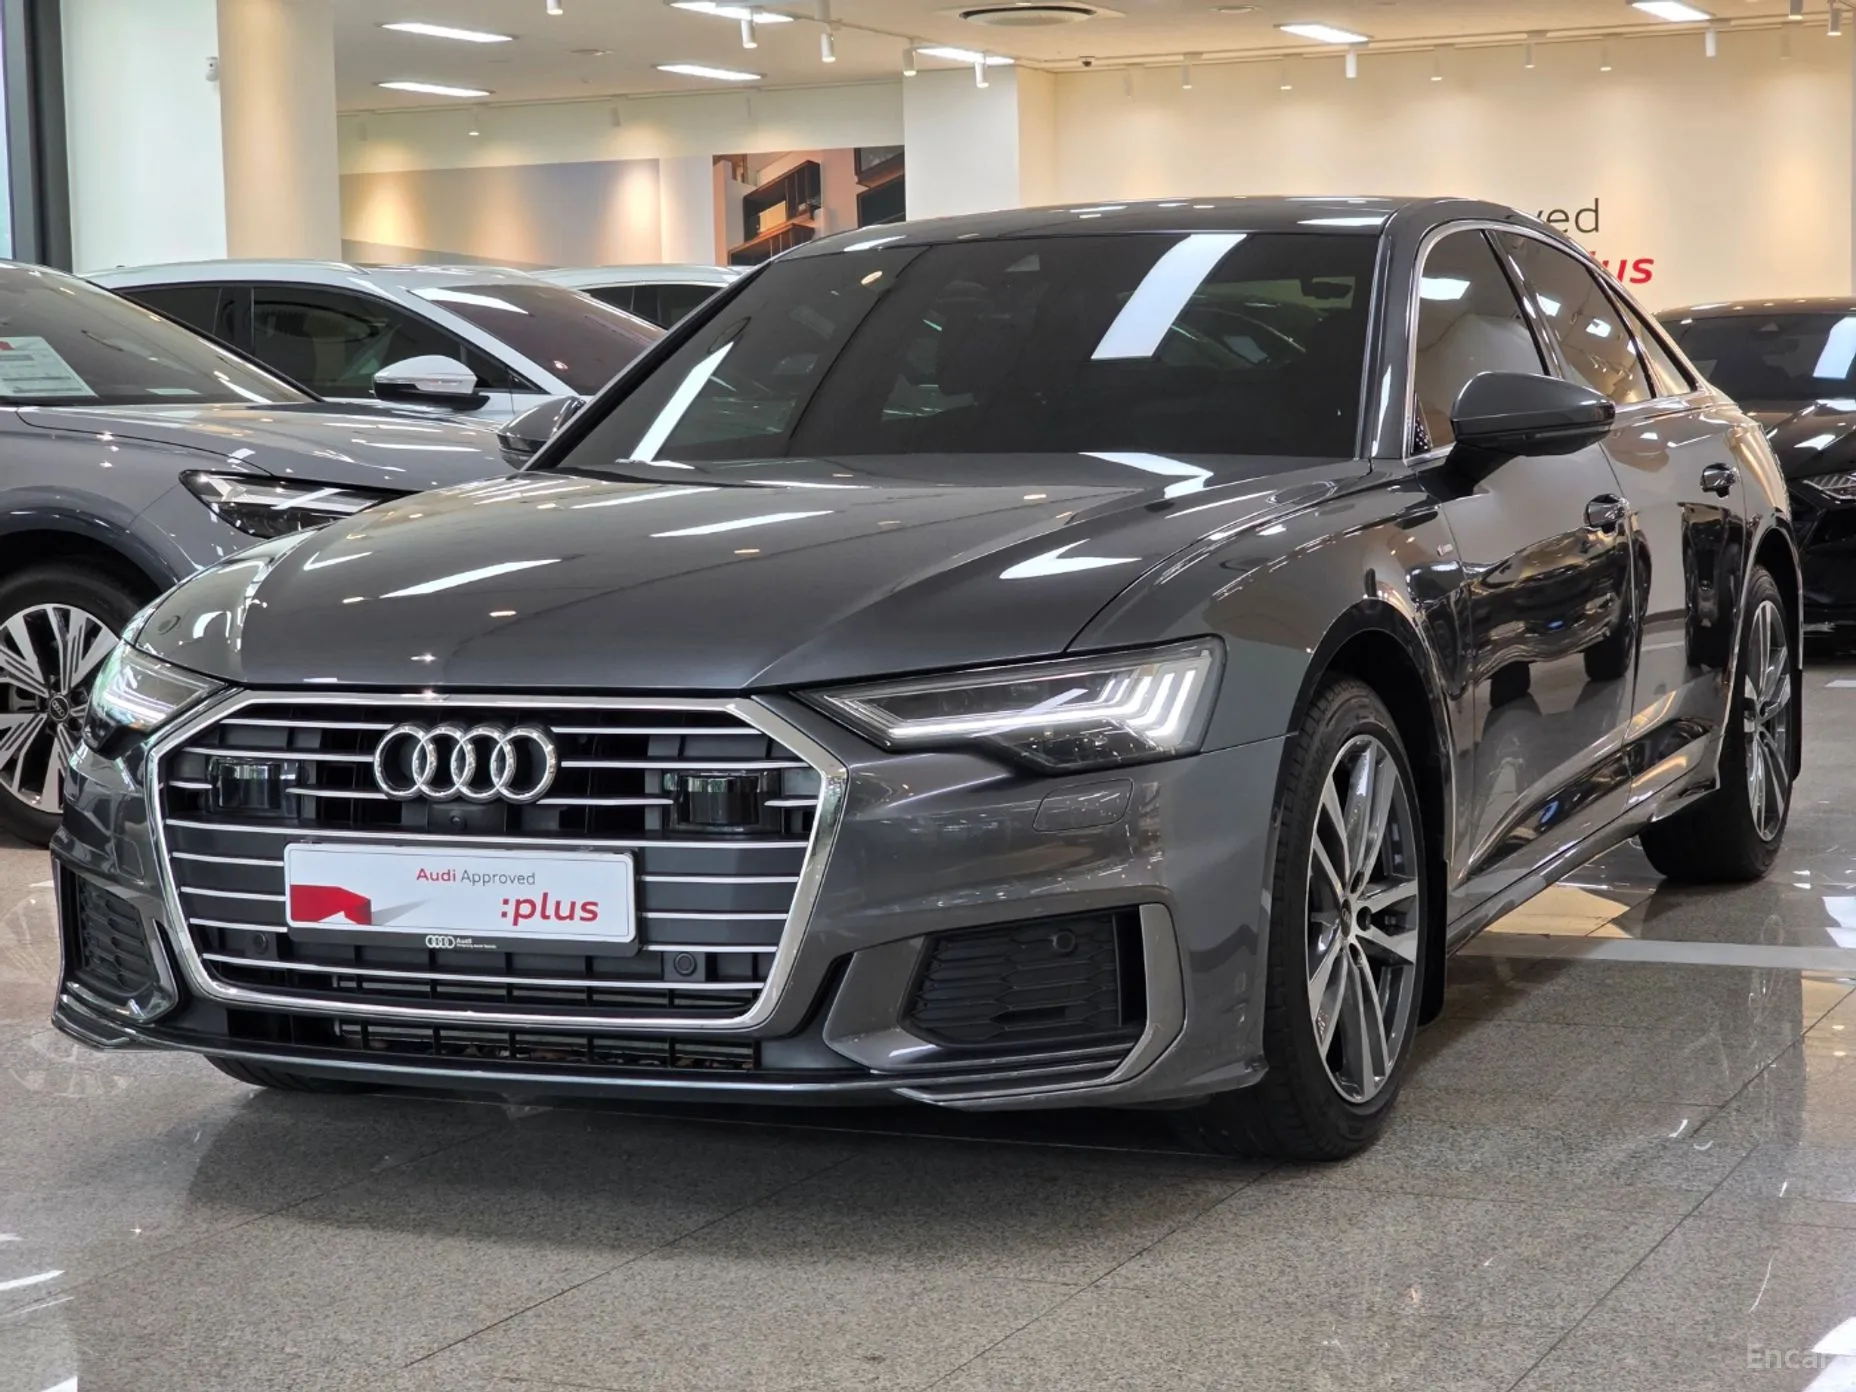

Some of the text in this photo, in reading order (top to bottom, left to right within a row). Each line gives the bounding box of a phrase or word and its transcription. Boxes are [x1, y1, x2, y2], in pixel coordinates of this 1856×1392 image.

[1537, 197, 1600, 234] ed
[416, 867, 536, 886] Audi Approved
[500, 892, 600, 927] :plus
